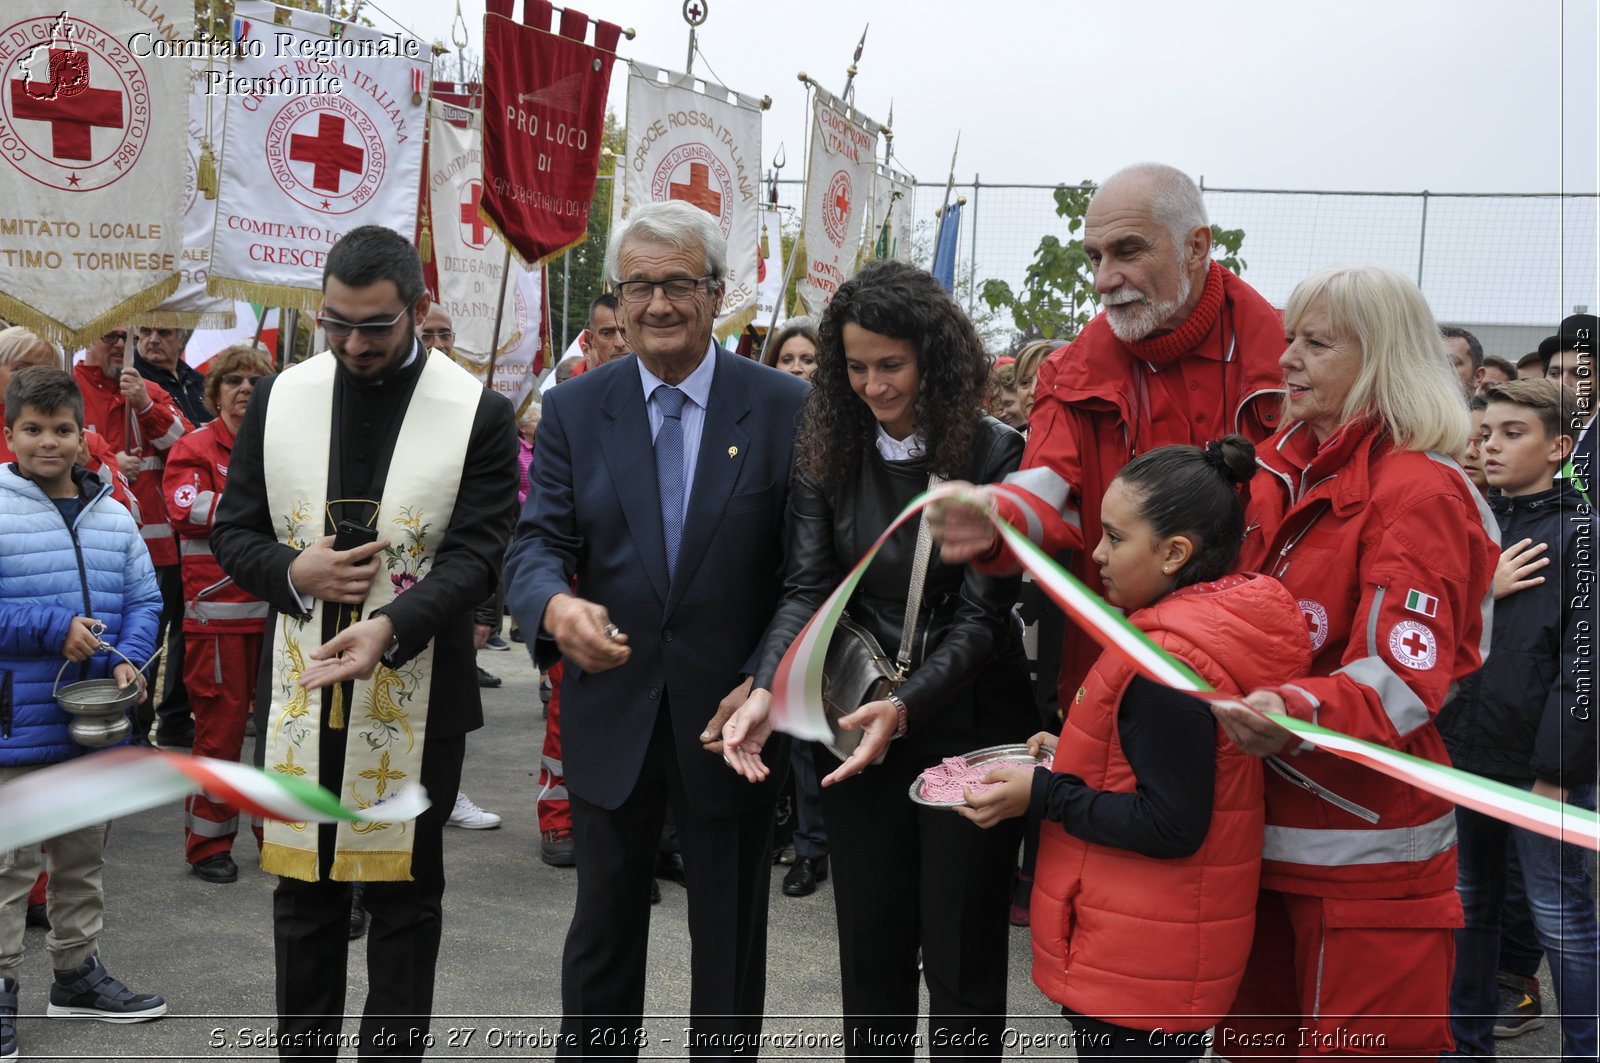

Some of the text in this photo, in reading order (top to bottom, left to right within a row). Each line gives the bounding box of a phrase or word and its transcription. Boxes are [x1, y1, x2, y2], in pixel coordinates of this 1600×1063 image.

[10, 28, 31, 49] DI
[31, 23, 108, 53] GINEVRA
[107, 46, 130, 69] 22
[123, 68, 147, 140] AGOSTO
[294, 57, 348, 79] ROSSA
[352, 69, 409, 144] ITALIANA
[506, 105, 588, 151] PRO LOCO
[113, 140, 139, 171] 1864
[269, 96, 384, 205] CONVENZIONE DI GINEVRA 22 AGOSTO 1864
[537, 153, 552, 173] DI
[632, 110, 753, 203] CROCE ROSSA ITALIANA
[671, 151, 682, 164] DI
[681, 146, 716, 168] GINEVRA
[714, 164, 727, 179] 22
[90, 222, 161, 240] LOCALE
[228, 215, 322, 241] COMITATO
[0, 250, 175, 271] TIMO TORINESE
[181, 248, 210, 262] ALE
[249, 243, 329, 269] CRESCE
[474, 281, 485, 294] DI
